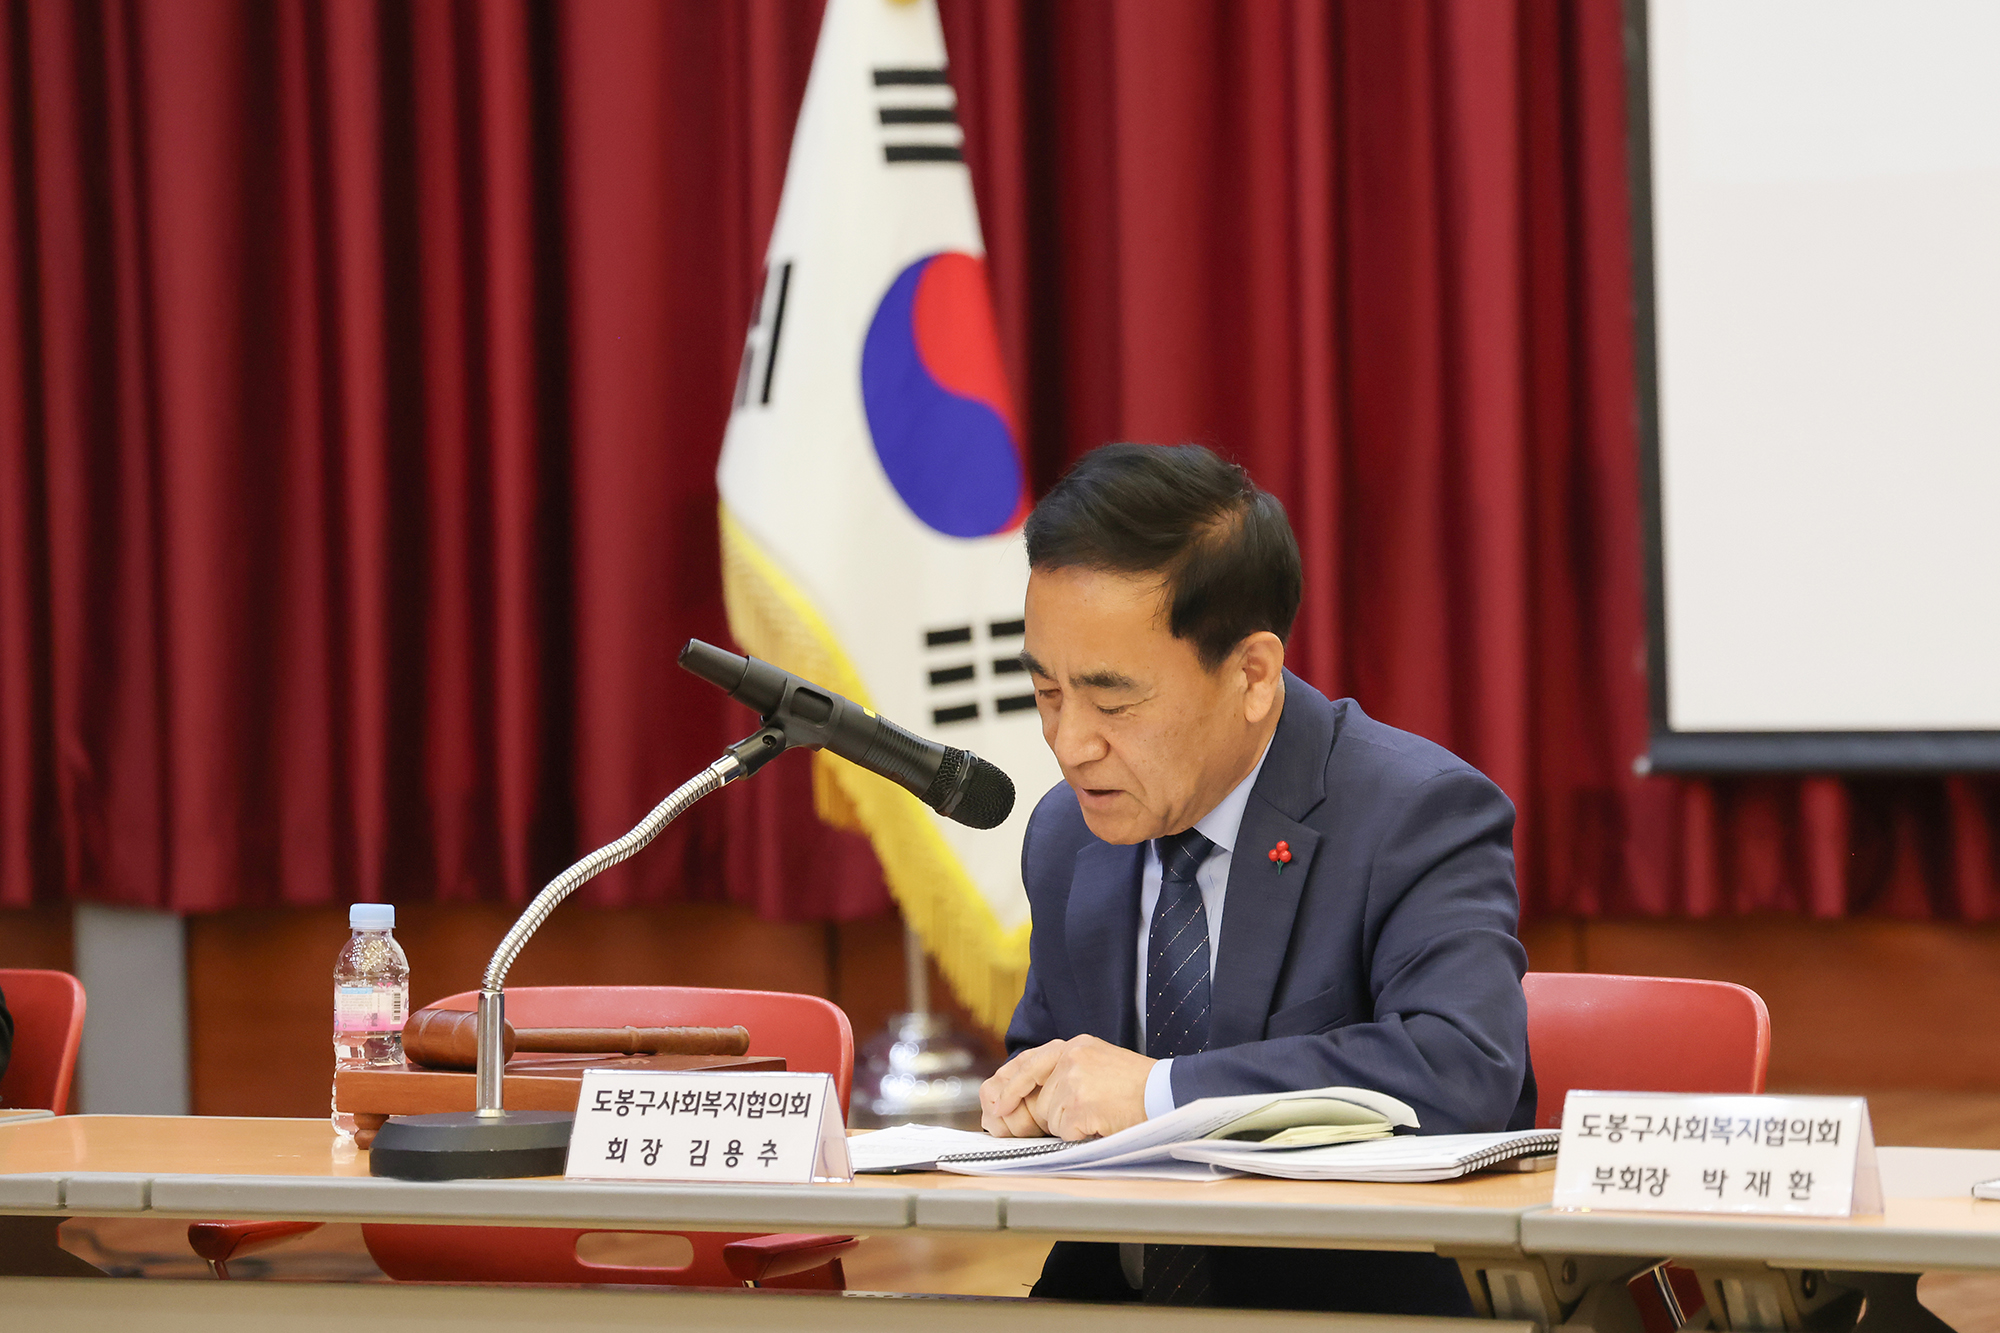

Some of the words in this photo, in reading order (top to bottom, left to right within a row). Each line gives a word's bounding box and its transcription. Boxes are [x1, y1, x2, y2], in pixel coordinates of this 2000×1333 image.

[591, 1089, 812, 1119] 도봉구사회복지협의회
[1578, 1114, 1842, 1147] 도봉구사회복지협의회
[1592, 1166, 1669, 1197] 부회장
